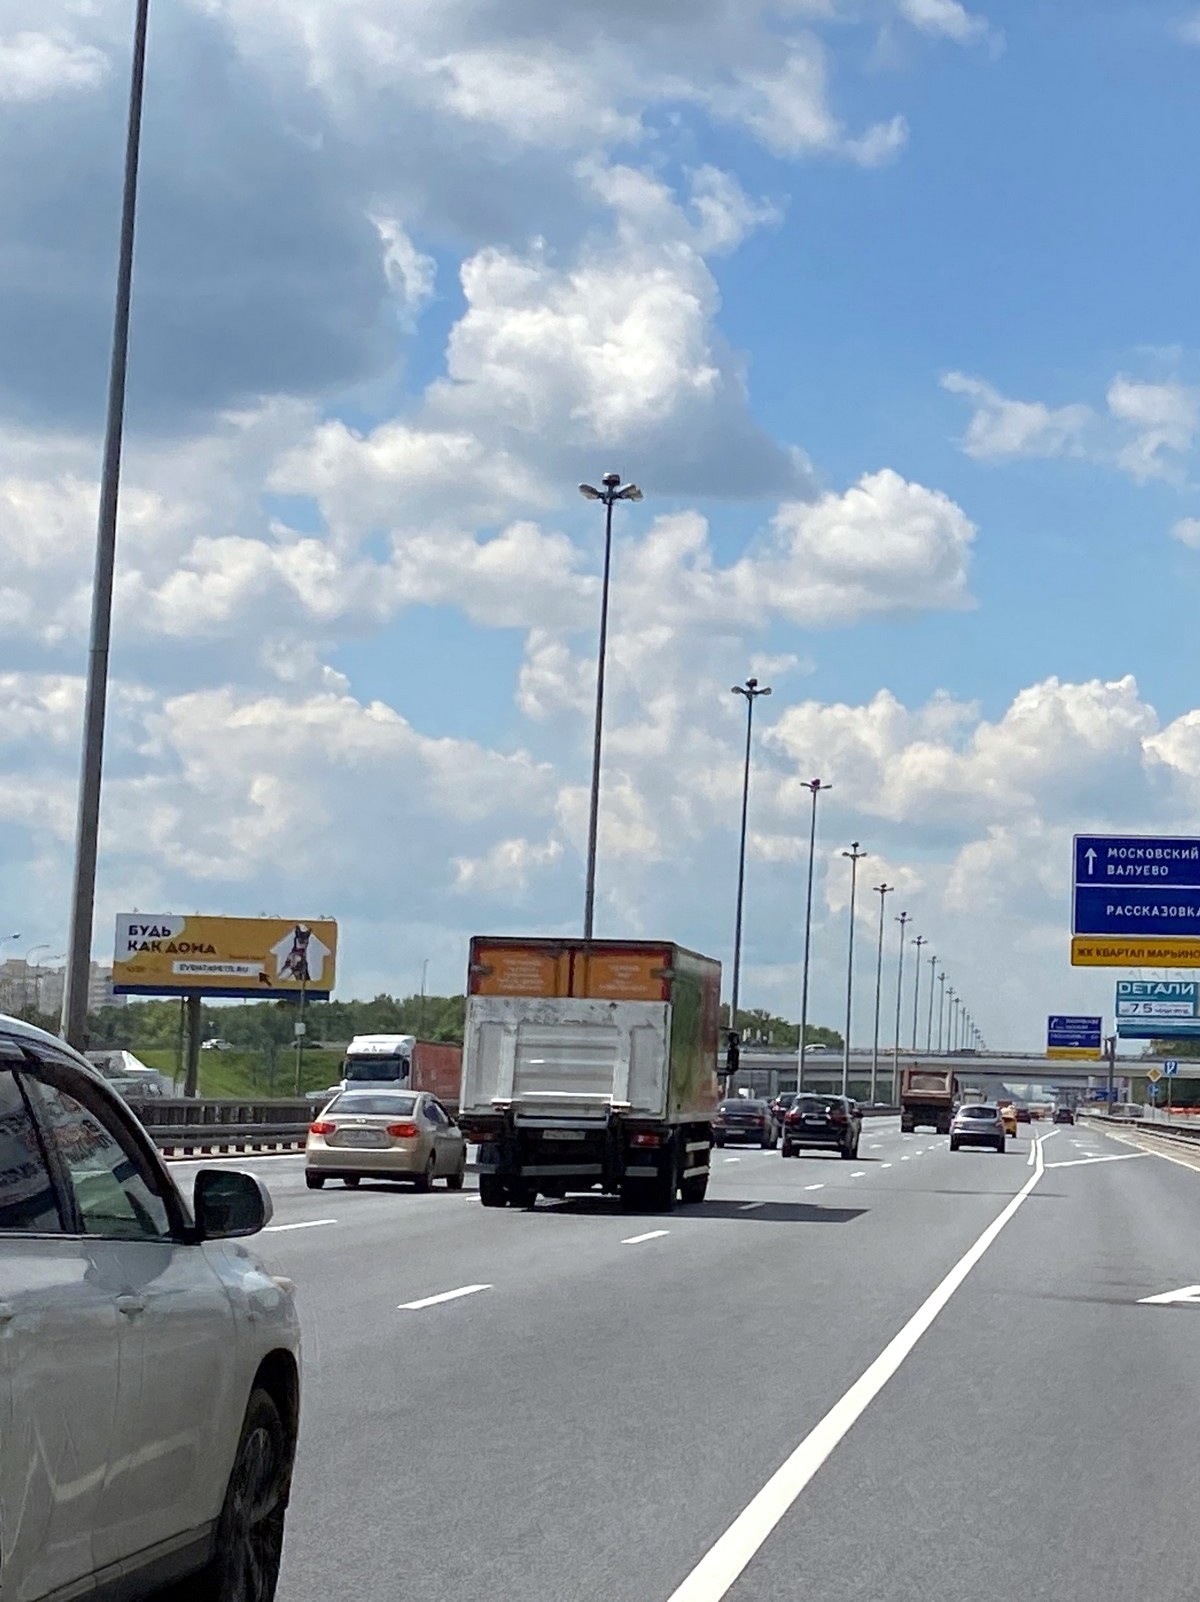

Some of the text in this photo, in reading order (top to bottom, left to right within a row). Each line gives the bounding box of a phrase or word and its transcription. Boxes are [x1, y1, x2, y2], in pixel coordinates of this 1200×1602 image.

[1107, 846, 1199, 860] МОСКОВСКИЙ
[1107, 864, 1169, 876] ВАЛУЕВО
[128, 924, 172, 938] БУДЬ
[127, 940, 162, 953] КАК
[1078, 948, 1093, 957] ЖК
[1096, 948, 1145, 958] КВАРТАЛ
[1147, 949, 1200, 959] МАРЬИНО
